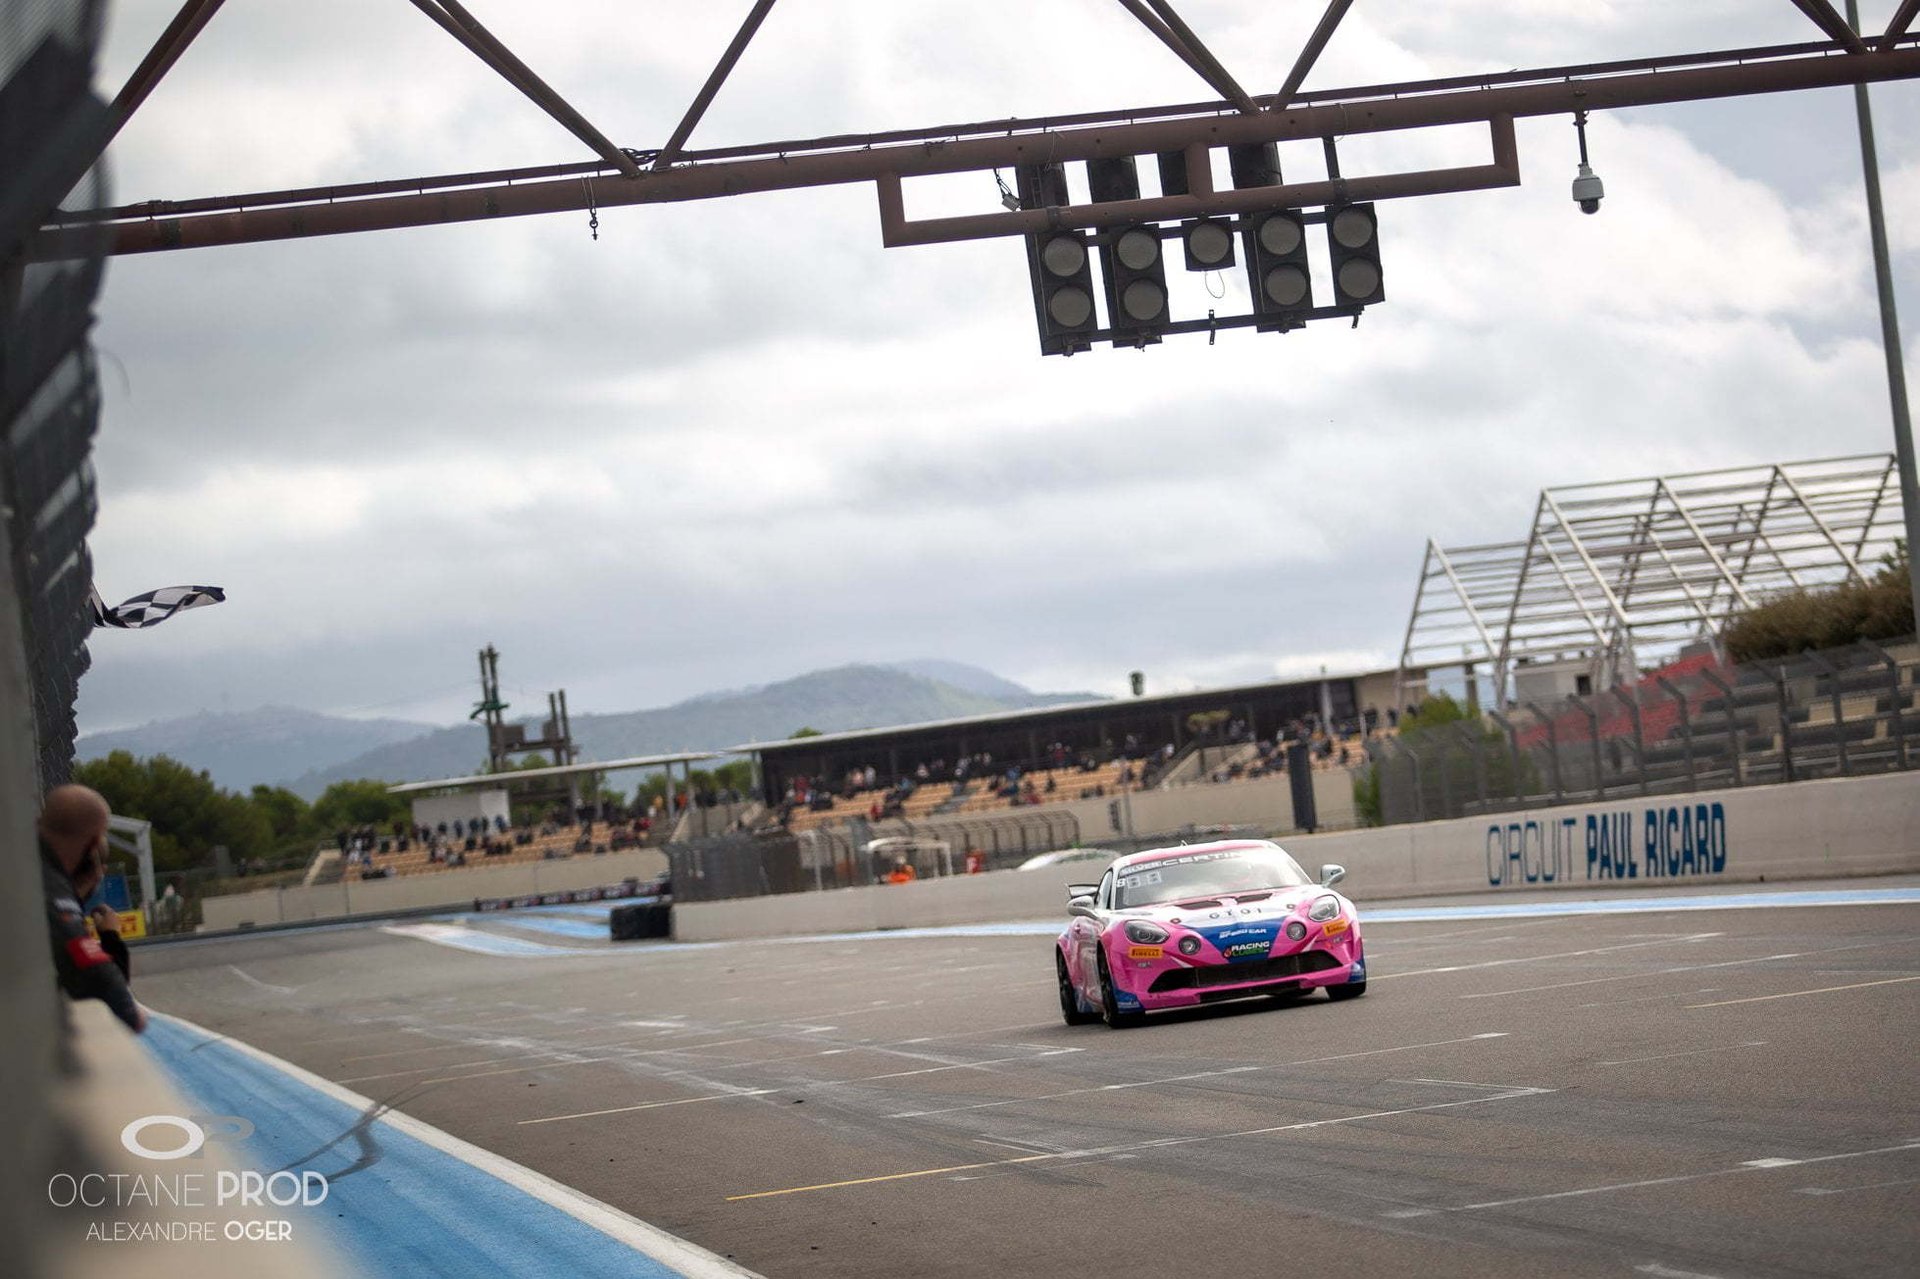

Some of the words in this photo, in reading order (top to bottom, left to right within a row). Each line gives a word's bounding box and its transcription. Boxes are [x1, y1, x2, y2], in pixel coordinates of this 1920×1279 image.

[1487, 818, 1576, 886] CIRCUIT
[1586, 811, 1637, 880] PAUL
[1646, 802, 1726, 877] RICARD
[1162, 851, 1240, 867] CERTIN
[1231, 941, 1270, 951] RACING
